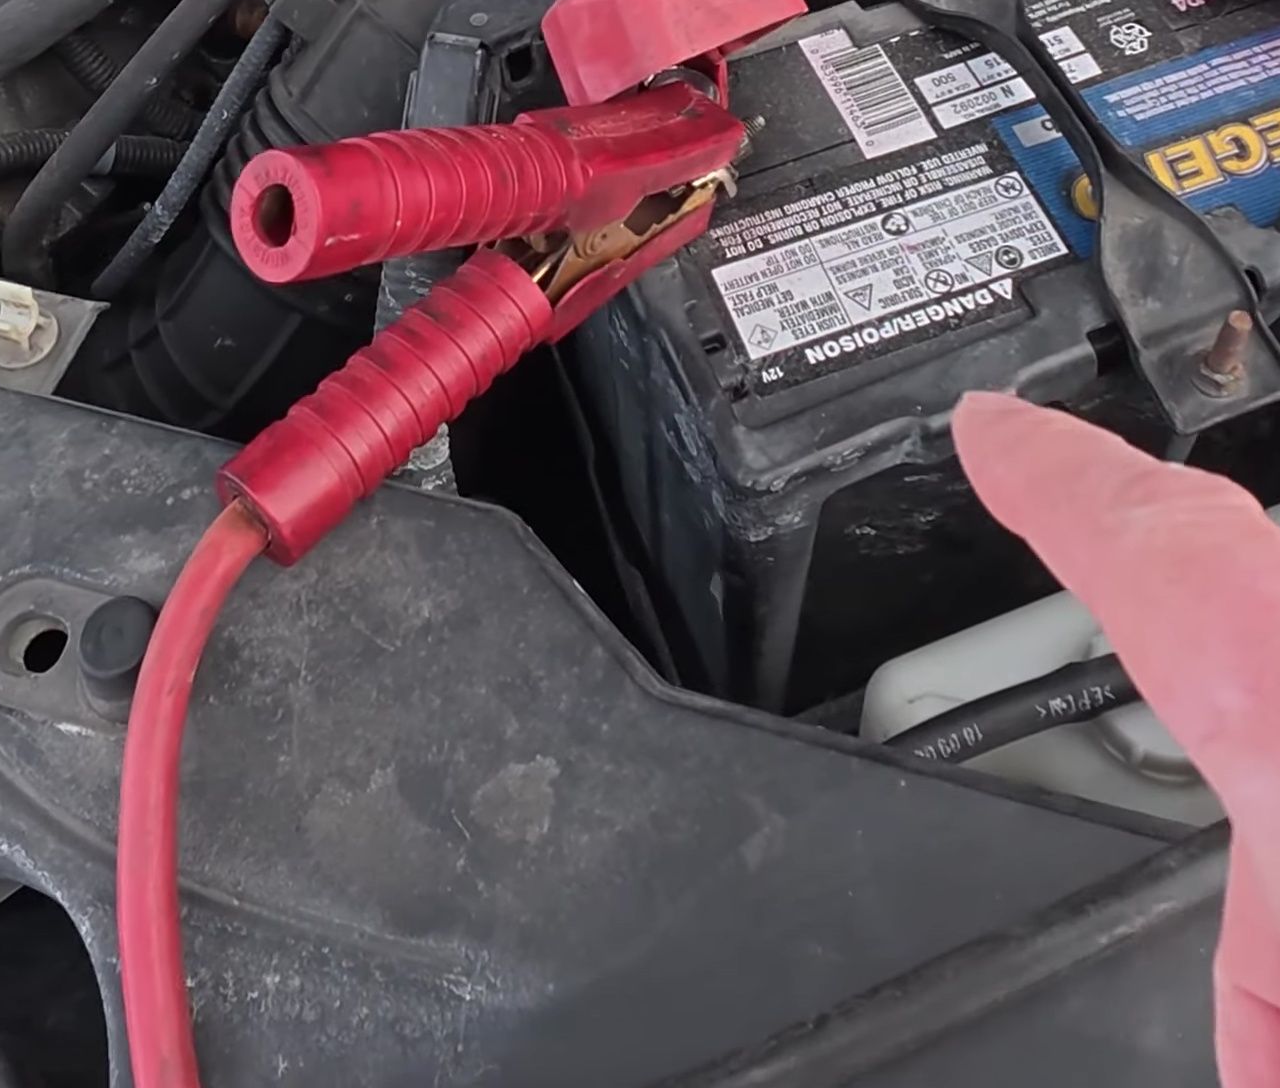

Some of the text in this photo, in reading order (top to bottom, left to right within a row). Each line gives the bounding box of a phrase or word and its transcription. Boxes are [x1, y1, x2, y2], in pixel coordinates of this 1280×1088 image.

[931, 71, 957, 88] 500
[950, 83, 1016, 115] N 002092
[941, 141, 988, 165] INVERTED
[875, 164, 916, 185] FOLLOW
[918, 154, 985, 184] DISASSEMBLE
[942, 163, 992, 188] WARNING:
[835, 177, 875, 199] PROPER
[902, 176, 918, 188] OR
[917, 179, 942, 196] RISK
[783, 190, 834, 215] CHARGING
[903, 188, 917, 200] OF
[952, 194, 963, 204] OF
[820, 200, 841, 214] NOT
[820, 200, 875, 227] EXPLOSION
[946, 206, 958, 217] OF
[958, 200, 976, 213] OUT
[1020, 201, 1032, 211] OR
[742, 206, 819, 240] RECOMMENDED
[929, 211, 944, 223] THE
[997, 214, 1021, 229] CAUSE
[1022, 209, 1037, 221] CAN
[803, 219, 819, 231] OR
[720, 233, 741, 247] FOR
[747, 238, 762, 250] DO
[845, 231, 883, 250] READ ALL
[968, 219, 1045, 253] EXPLOSIVE GASES
[723, 244, 745, 258] NOT
[780, 248, 797, 260] NOT
[798, 243, 811, 254] DO
[858, 249, 886, 265] SEVERE
[886, 245, 898, 255] OR
[1028, 241, 1060, 260] SHIELD
[721, 253, 816, 291] DO NOT OPEN BATTERY.
[835, 254, 903, 284] CAUSE BLINDNESS
[893, 264, 909, 276] CAN
[892, 274, 915, 290] ACID
[954, 272, 968, 284] NO
[728, 282, 778, 306] HELP FAST.
[878, 286, 923, 310] SULFURIC
[733, 289, 793, 318] GET MEDICAL
[774, 290, 834, 318] WITH WATER.
[779, 302, 839, 330] IMMEDIATELY
[791, 313, 845, 339] FLUSH EYES
[803, 286, 993, 366] DANGER/POISON
[760, 365, 784, 382] 12V
